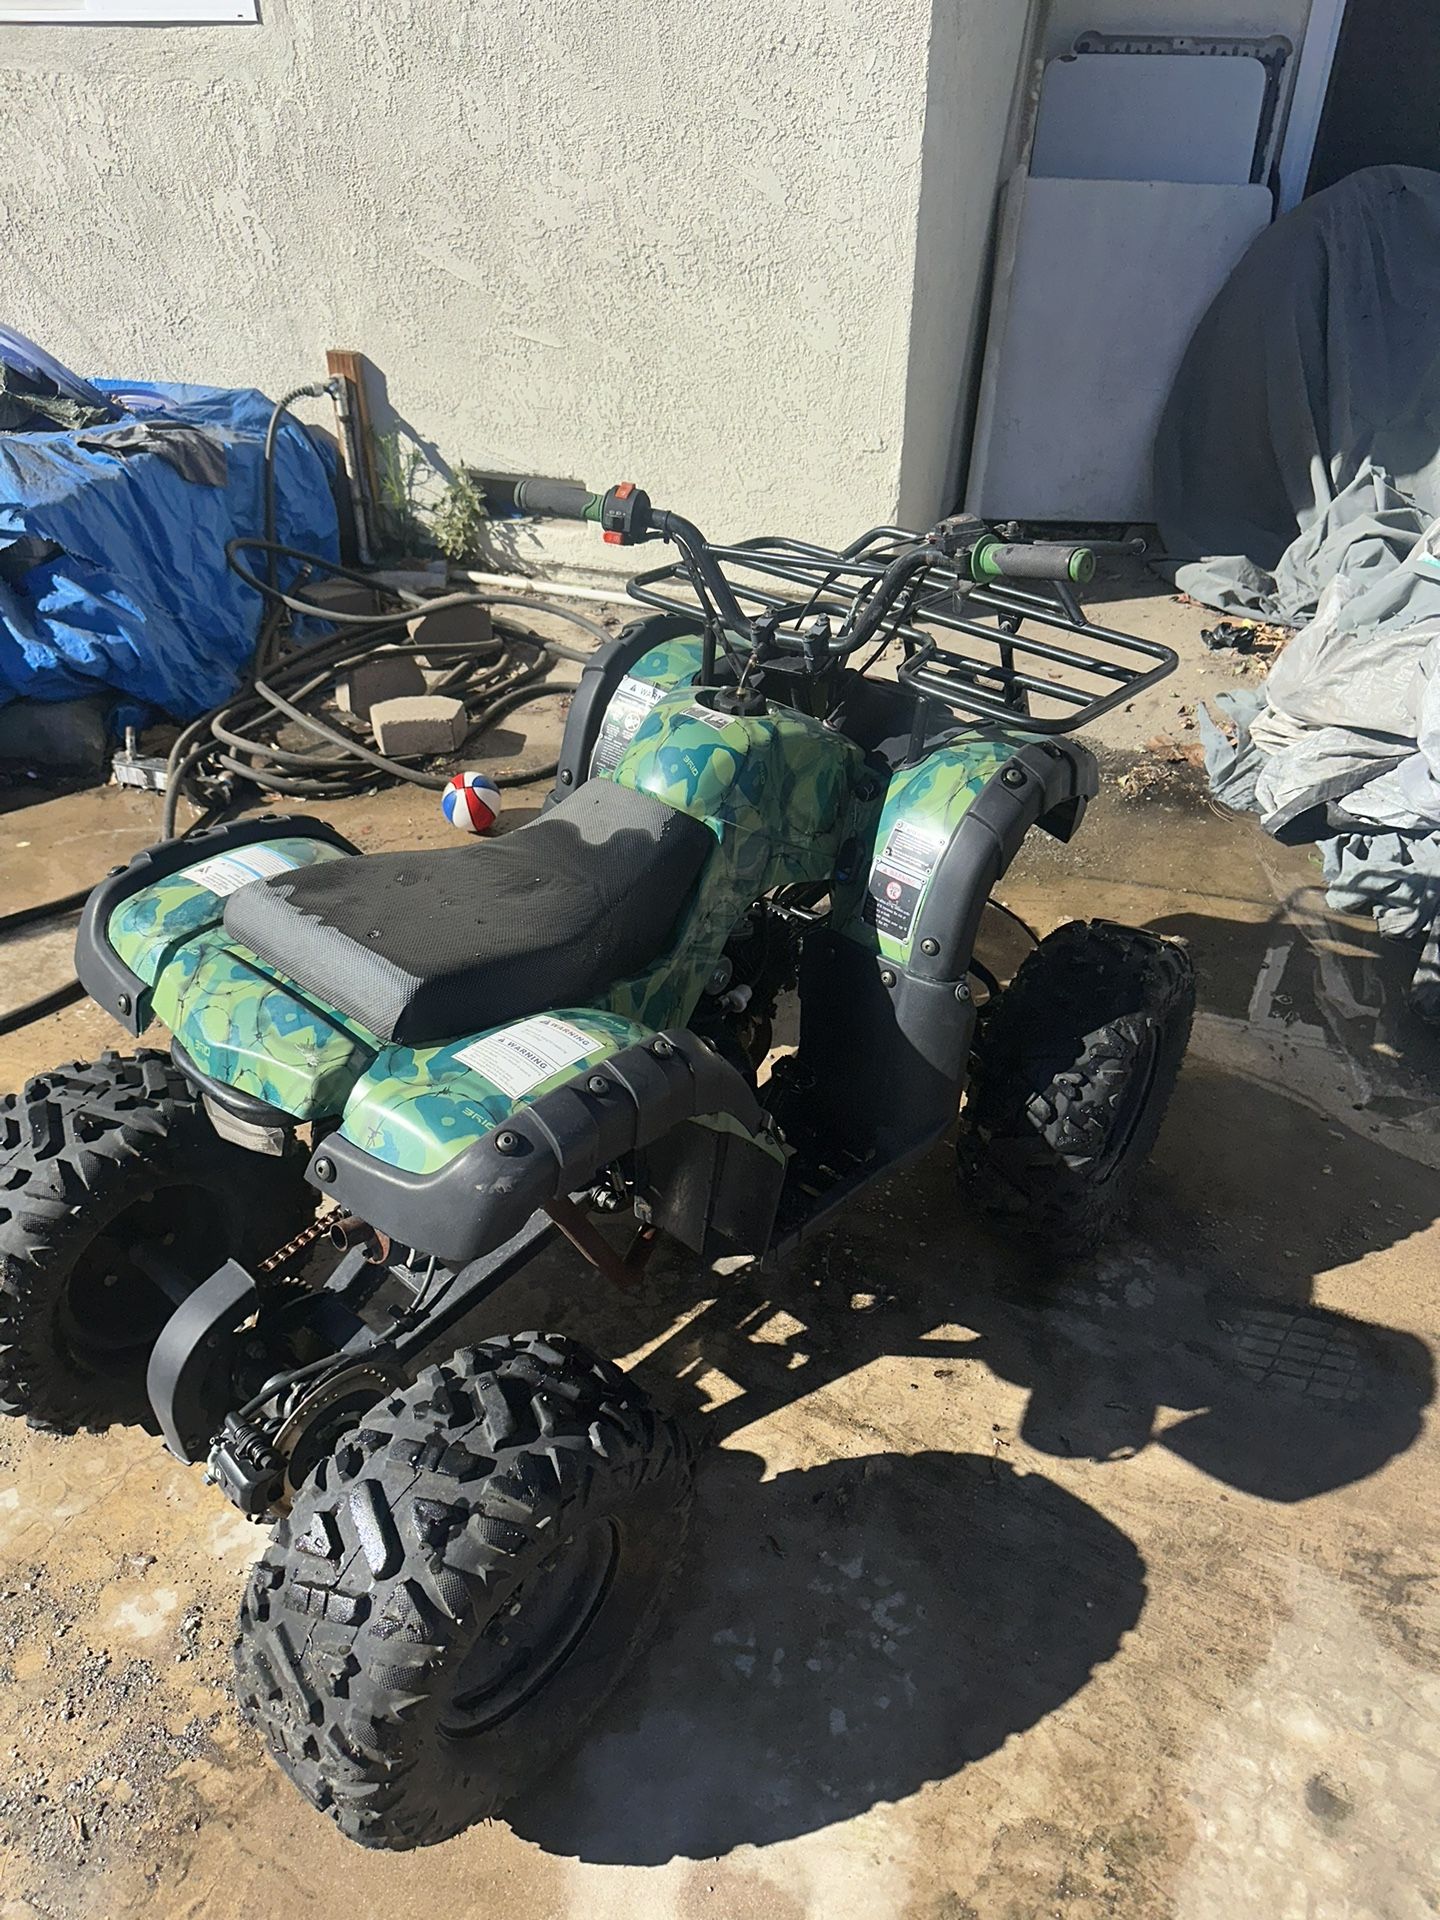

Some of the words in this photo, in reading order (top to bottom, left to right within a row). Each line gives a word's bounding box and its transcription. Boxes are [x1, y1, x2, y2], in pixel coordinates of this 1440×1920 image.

[640, 686, 663, 701] WARN
[551, 1021, 590, 1046] WARNING
[507, 1041, 548, 1070] WARNING
